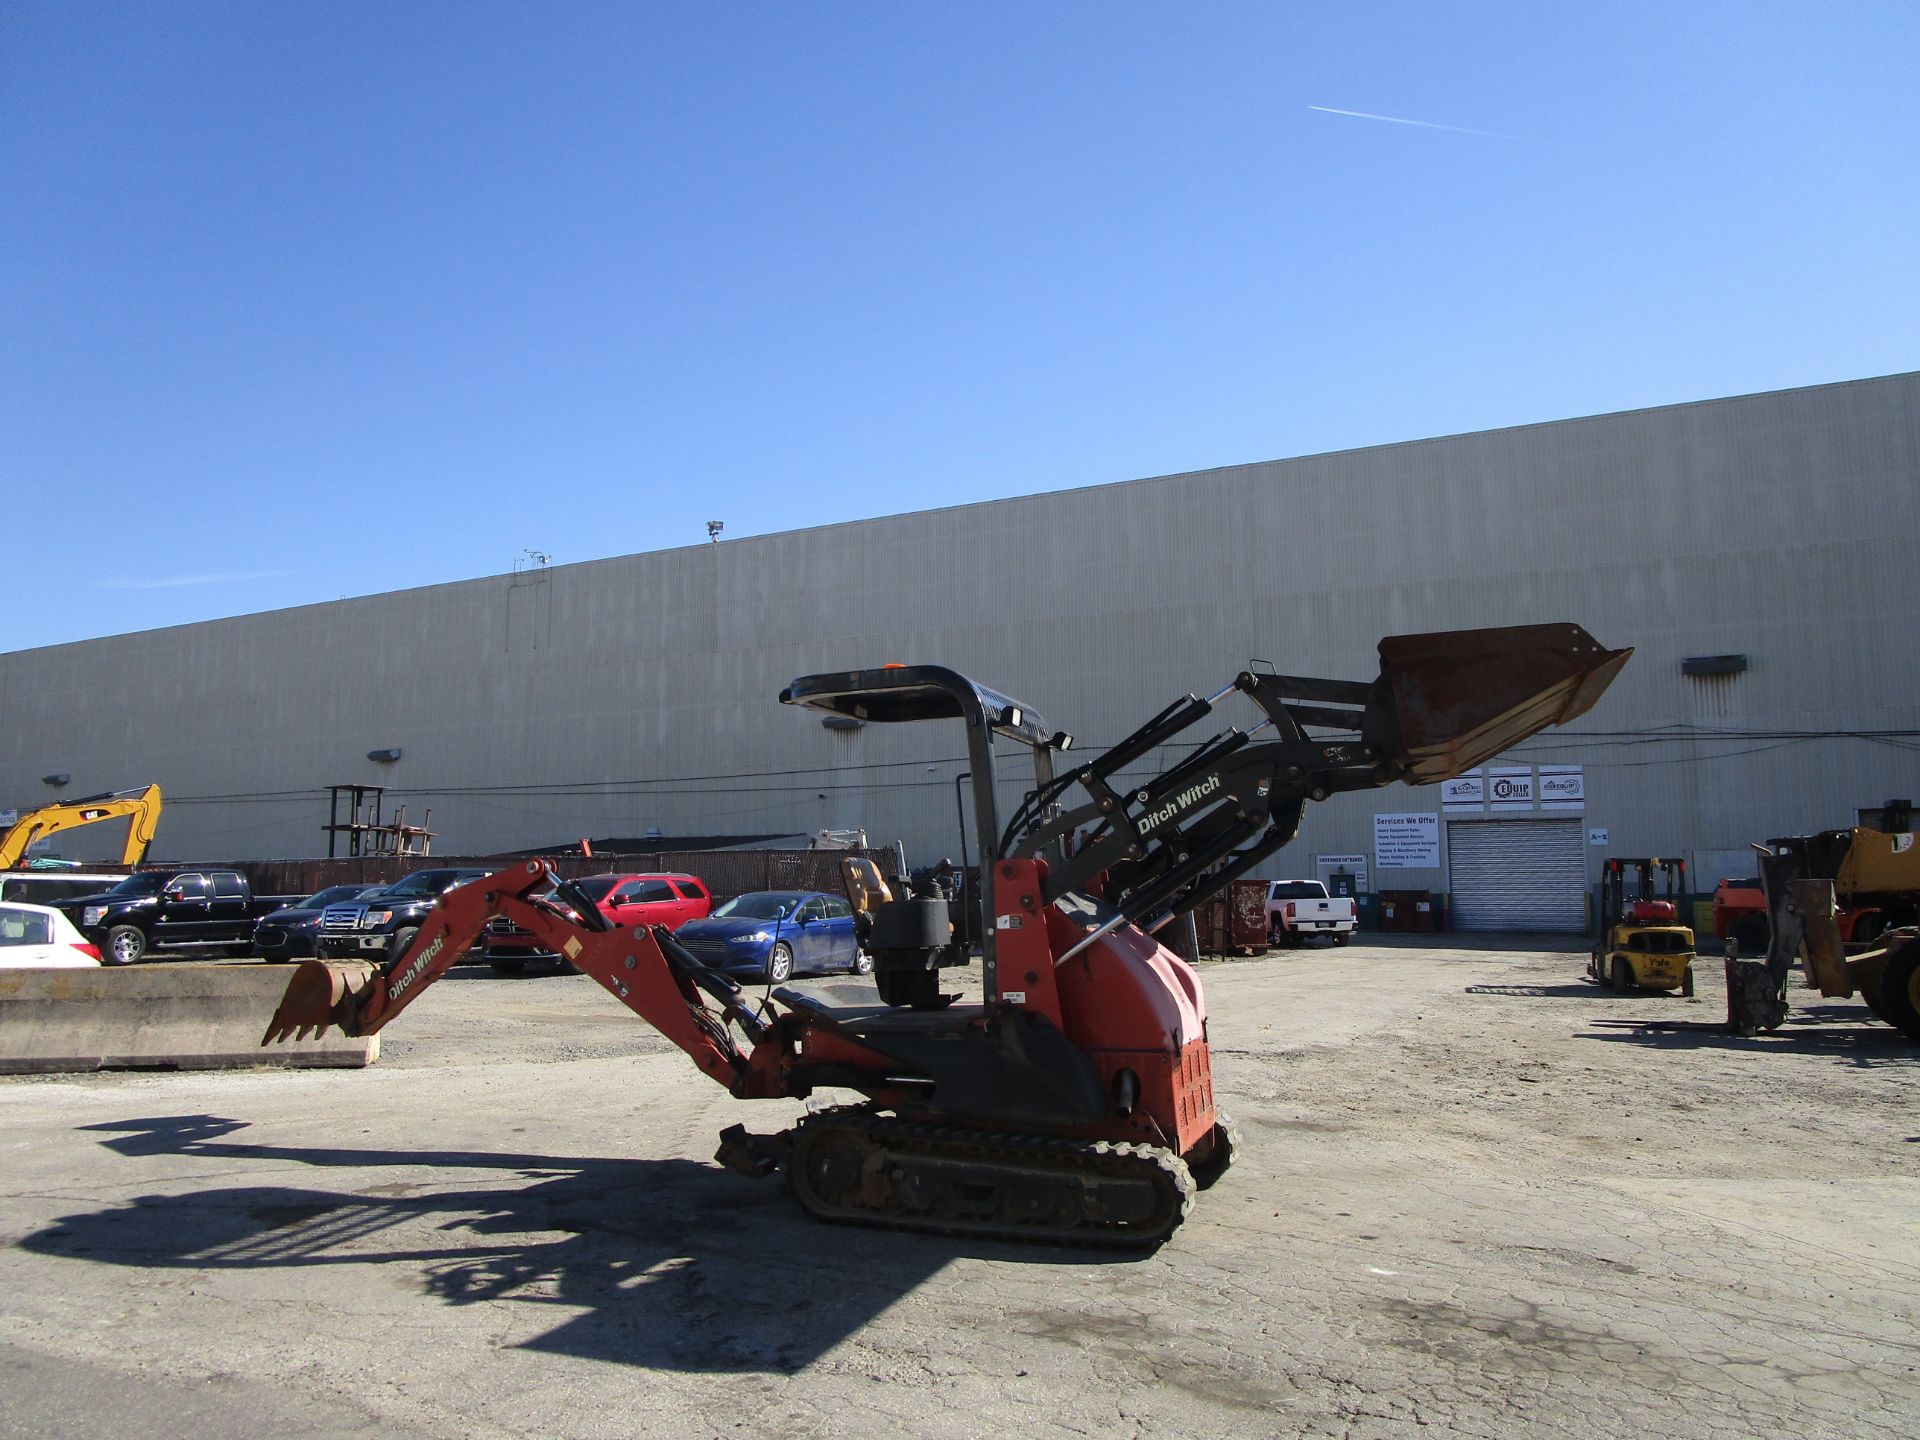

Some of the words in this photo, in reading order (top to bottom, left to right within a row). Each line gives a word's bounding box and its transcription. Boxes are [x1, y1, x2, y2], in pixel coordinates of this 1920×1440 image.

[1501, 784, 1529, 793] EQUIP
[1137, 803, 1178, 835] Ditch
[1176, 775, 1220, 809] Witch
[86, 810, 99, 820] CAT
[1376, 817, 1405, 825] Services
[1649, 958, 1671, 966] Yale
[388, 968, 416, 1000] Ditch
[413, 937, 443, 972] Witch
